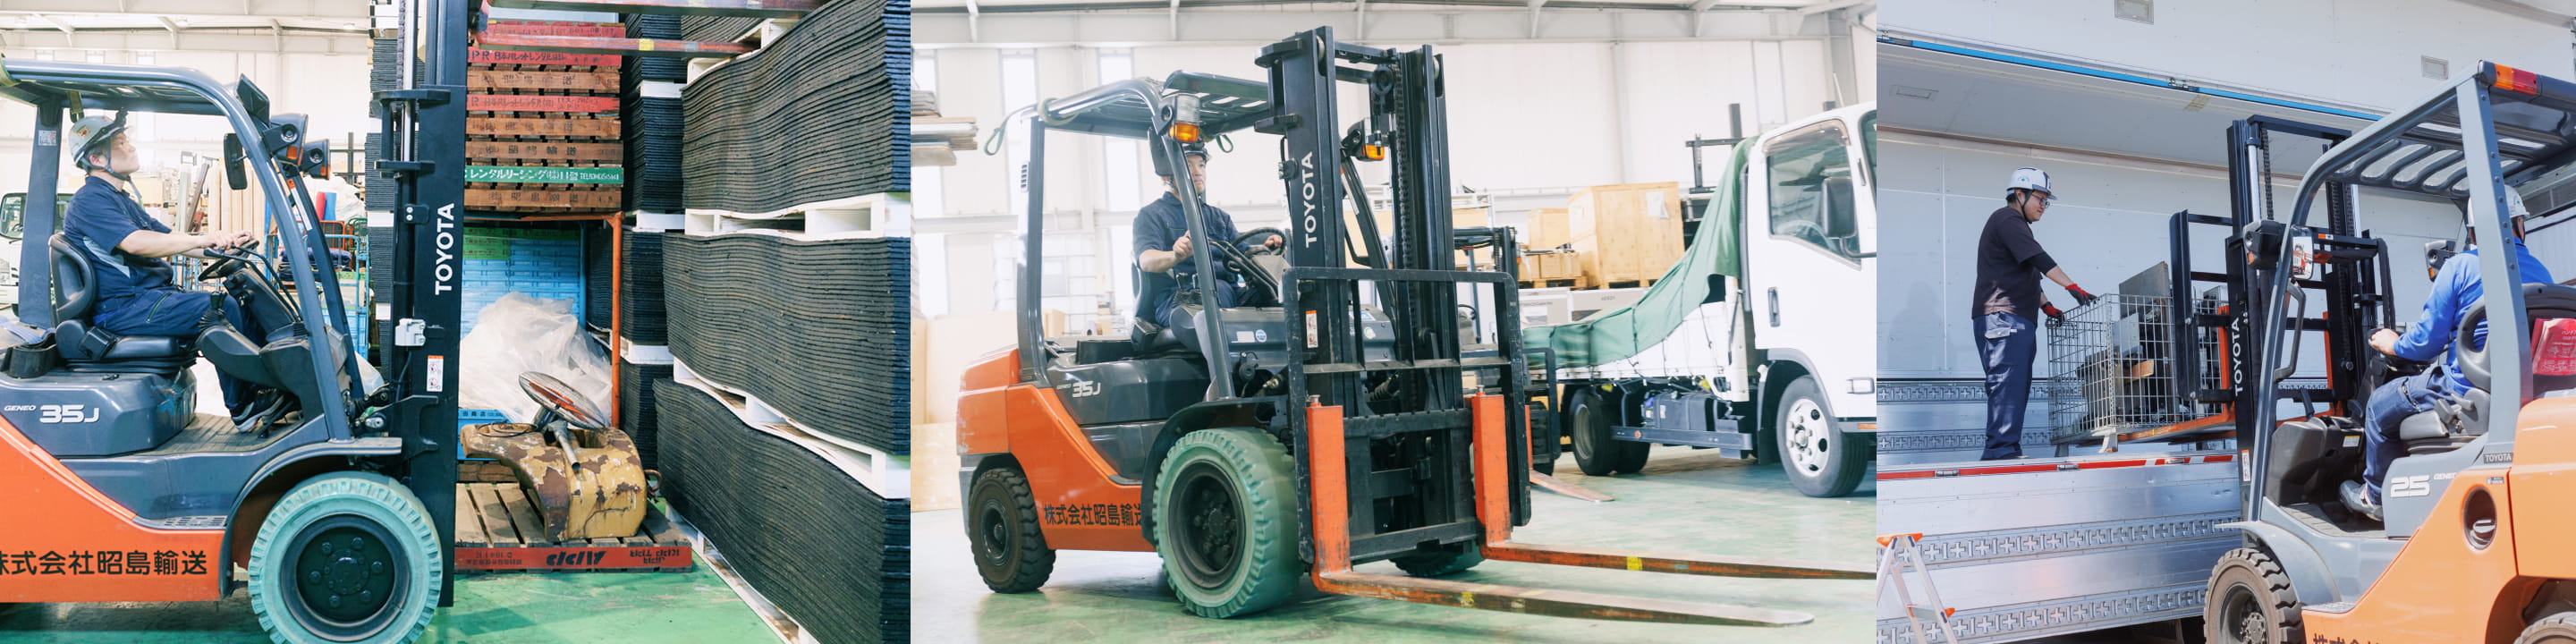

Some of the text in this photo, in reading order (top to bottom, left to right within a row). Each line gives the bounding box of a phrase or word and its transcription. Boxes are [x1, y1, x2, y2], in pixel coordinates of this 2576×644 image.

[1301, 151, 1318, 249] TOYOTA
[435, 202, 455, 295] TOYOTA
[2232, 317, 2244, 397] TOYOTA
[1072, 380, 1101, 398] 35J
[38, 404, 100, 423] 35J
[2486, 453, 2512, 462] TOYOTA
[2390, 474, 2430, 498] 25
